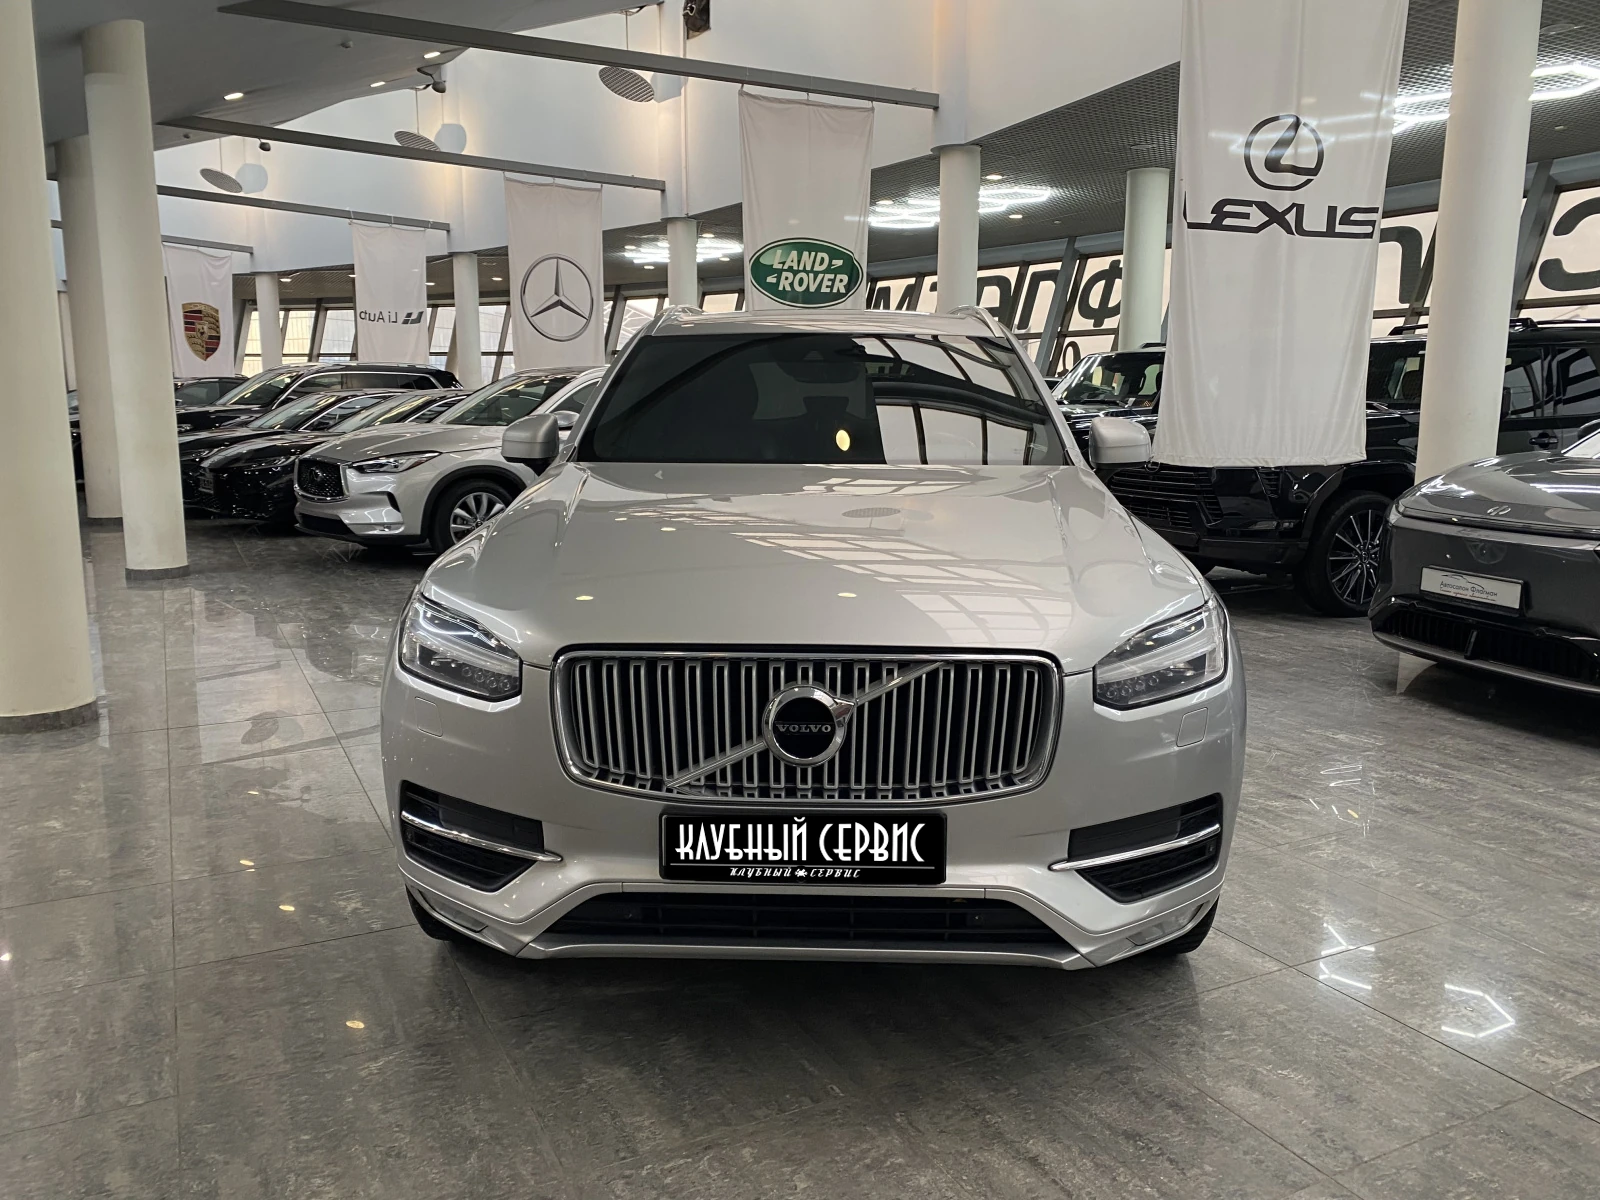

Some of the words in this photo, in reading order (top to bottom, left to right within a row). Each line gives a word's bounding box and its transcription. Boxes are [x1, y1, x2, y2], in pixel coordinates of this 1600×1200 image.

[1183, 191, 1380, 239] LEXUS
[772, 249, 830, 272] LAND
[778, 271, 849, 294] ROVER
[1440, 580, 1469, 592] Автосалон
[1470, 586, 1498, 597] Флагман
[775, 723, 833, 734] VOLVO
[674, 816, 807, 861] КЛУБНЫЙ
[818, 821, 926, 862] СЕРВИС
[729, 866, 792, 879] КЛУБНЫЙ
[809, 868, 861, 878] СЕРВИС
